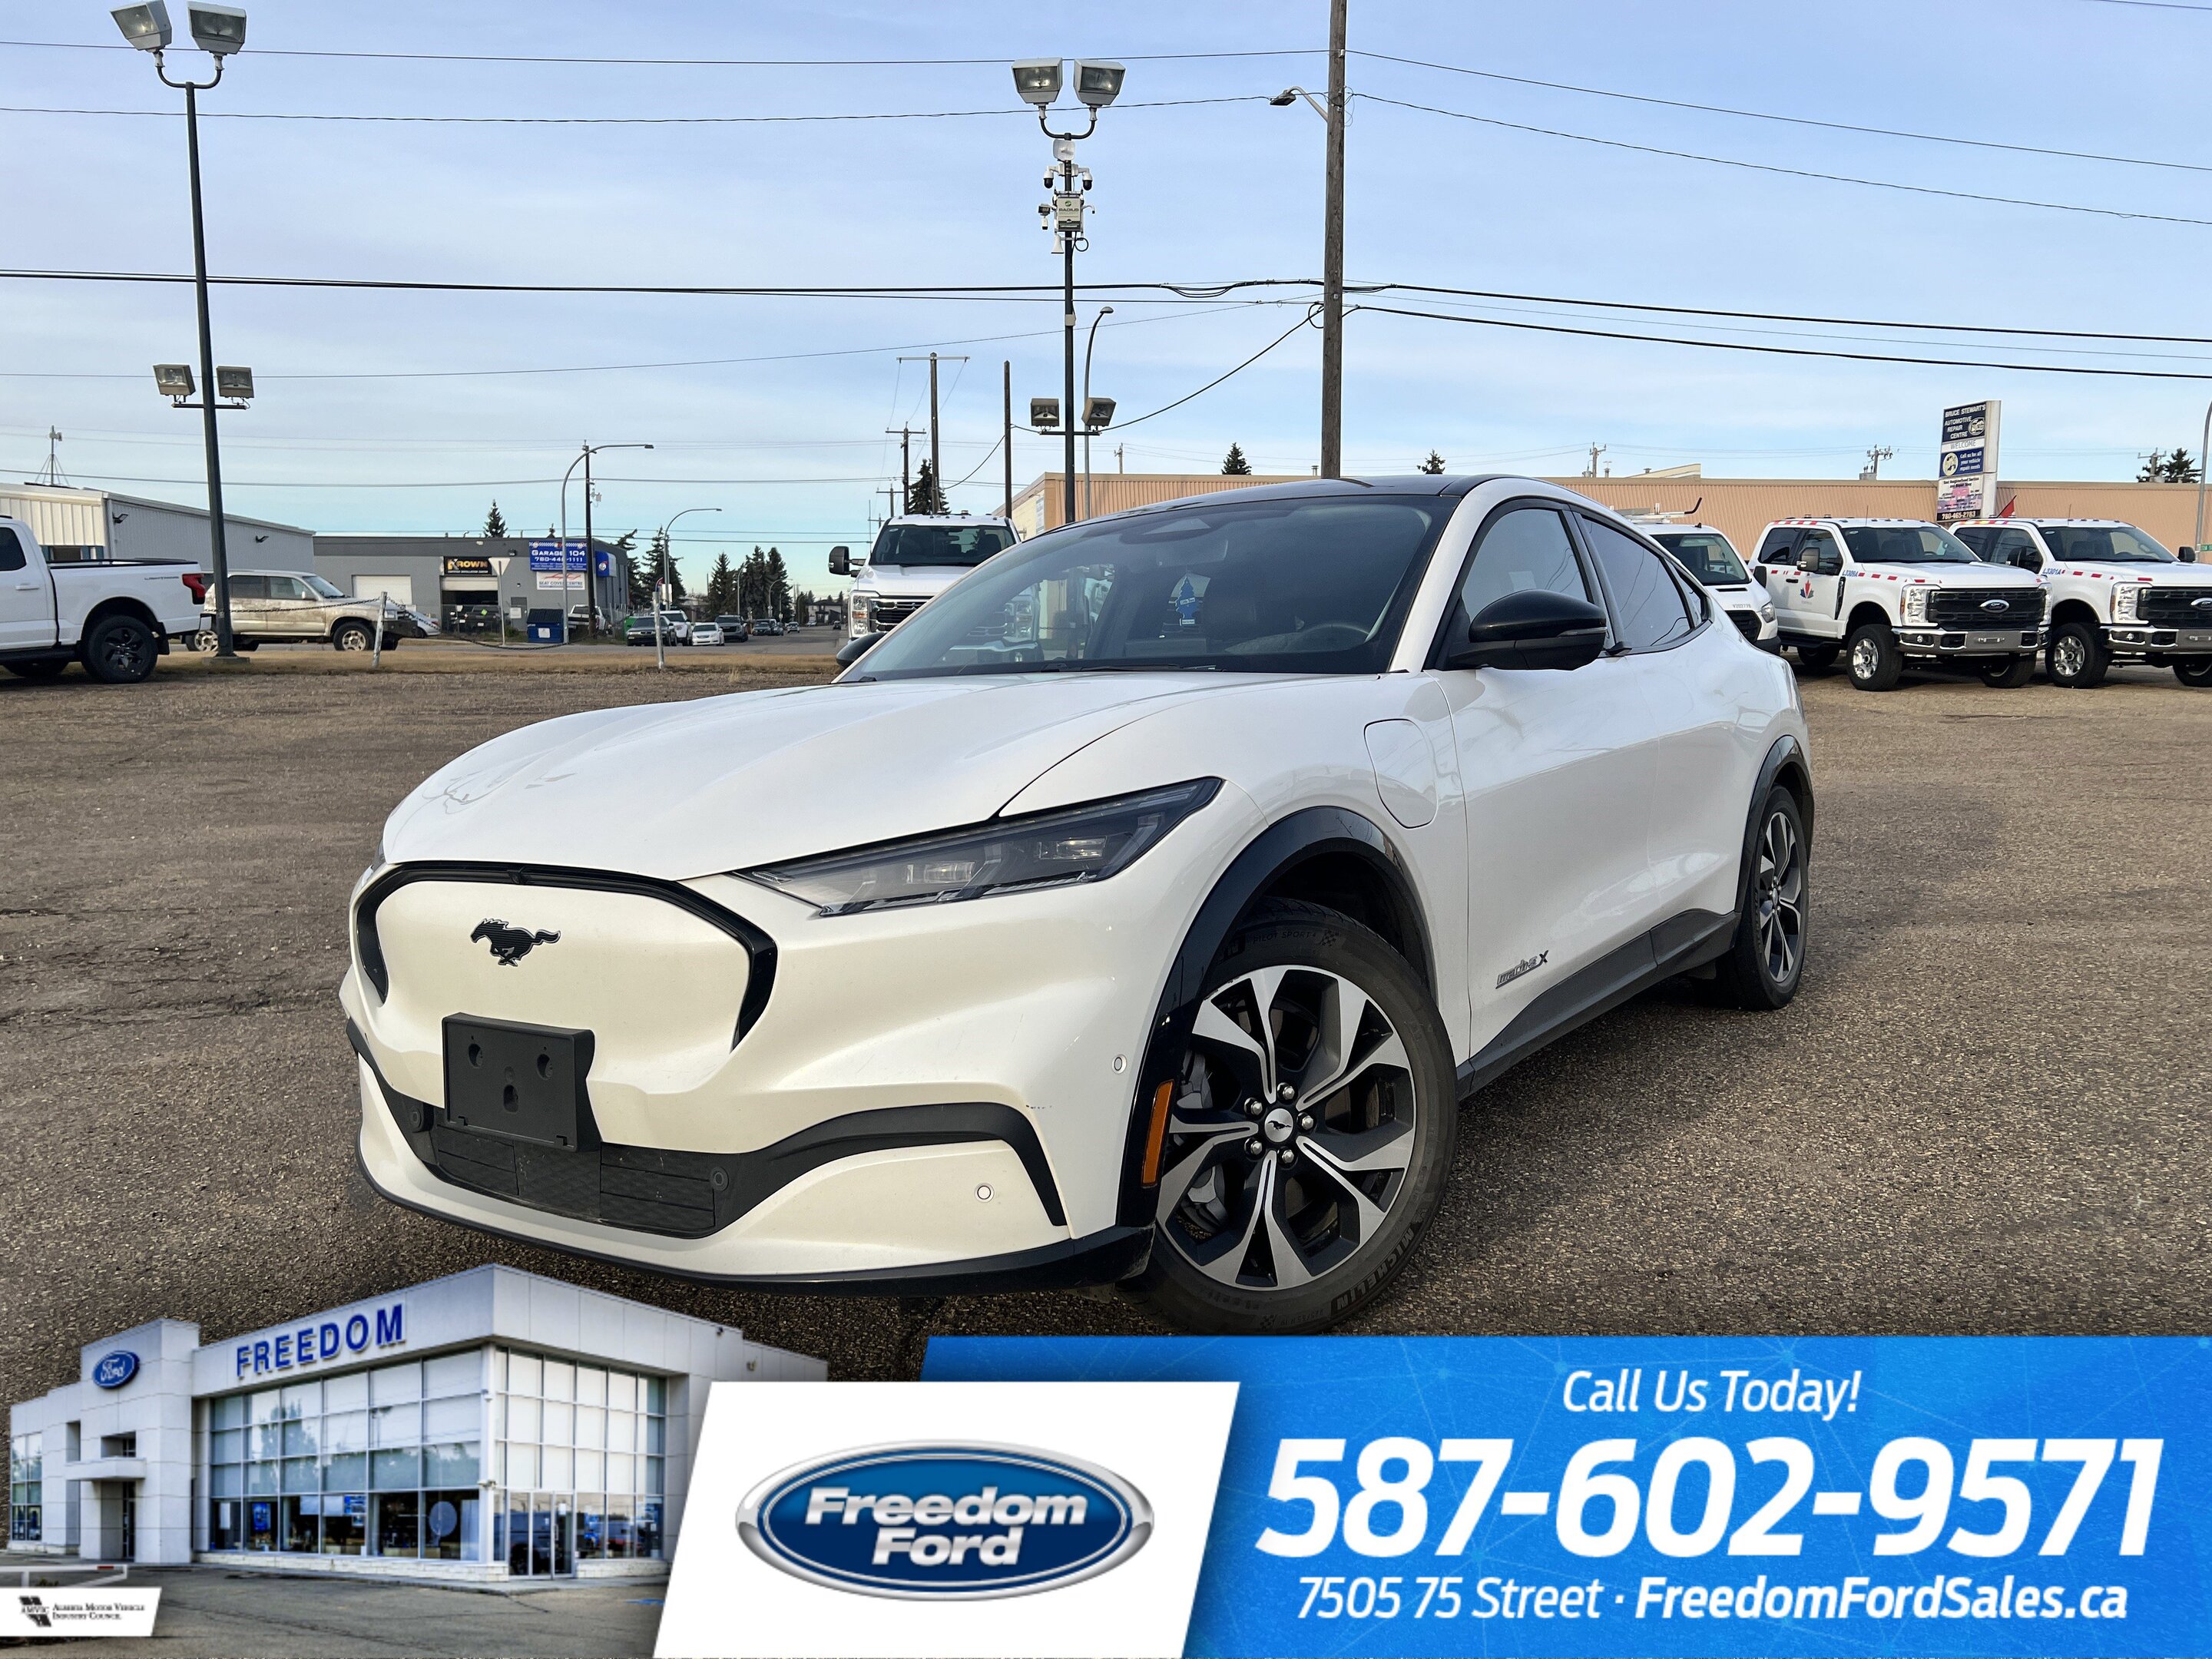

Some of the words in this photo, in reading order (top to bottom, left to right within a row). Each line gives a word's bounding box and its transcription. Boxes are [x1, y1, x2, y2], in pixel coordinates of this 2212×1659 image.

[1961, 404, 1986, 415] STEWART'S
[1944, 416, 1972, 426] AUTOMOTIVE
[1950, 431, 1968, 439] CENTRE
[1951, 439, 1976, 449] WELCOME
[447, 558, 488, 571] KROWN
[1253, 932, 1278, 945] PILOT
[1281, 930, 1311, 939] SPORT
[1336, 1228, 1415, 1310] MICHELIN
